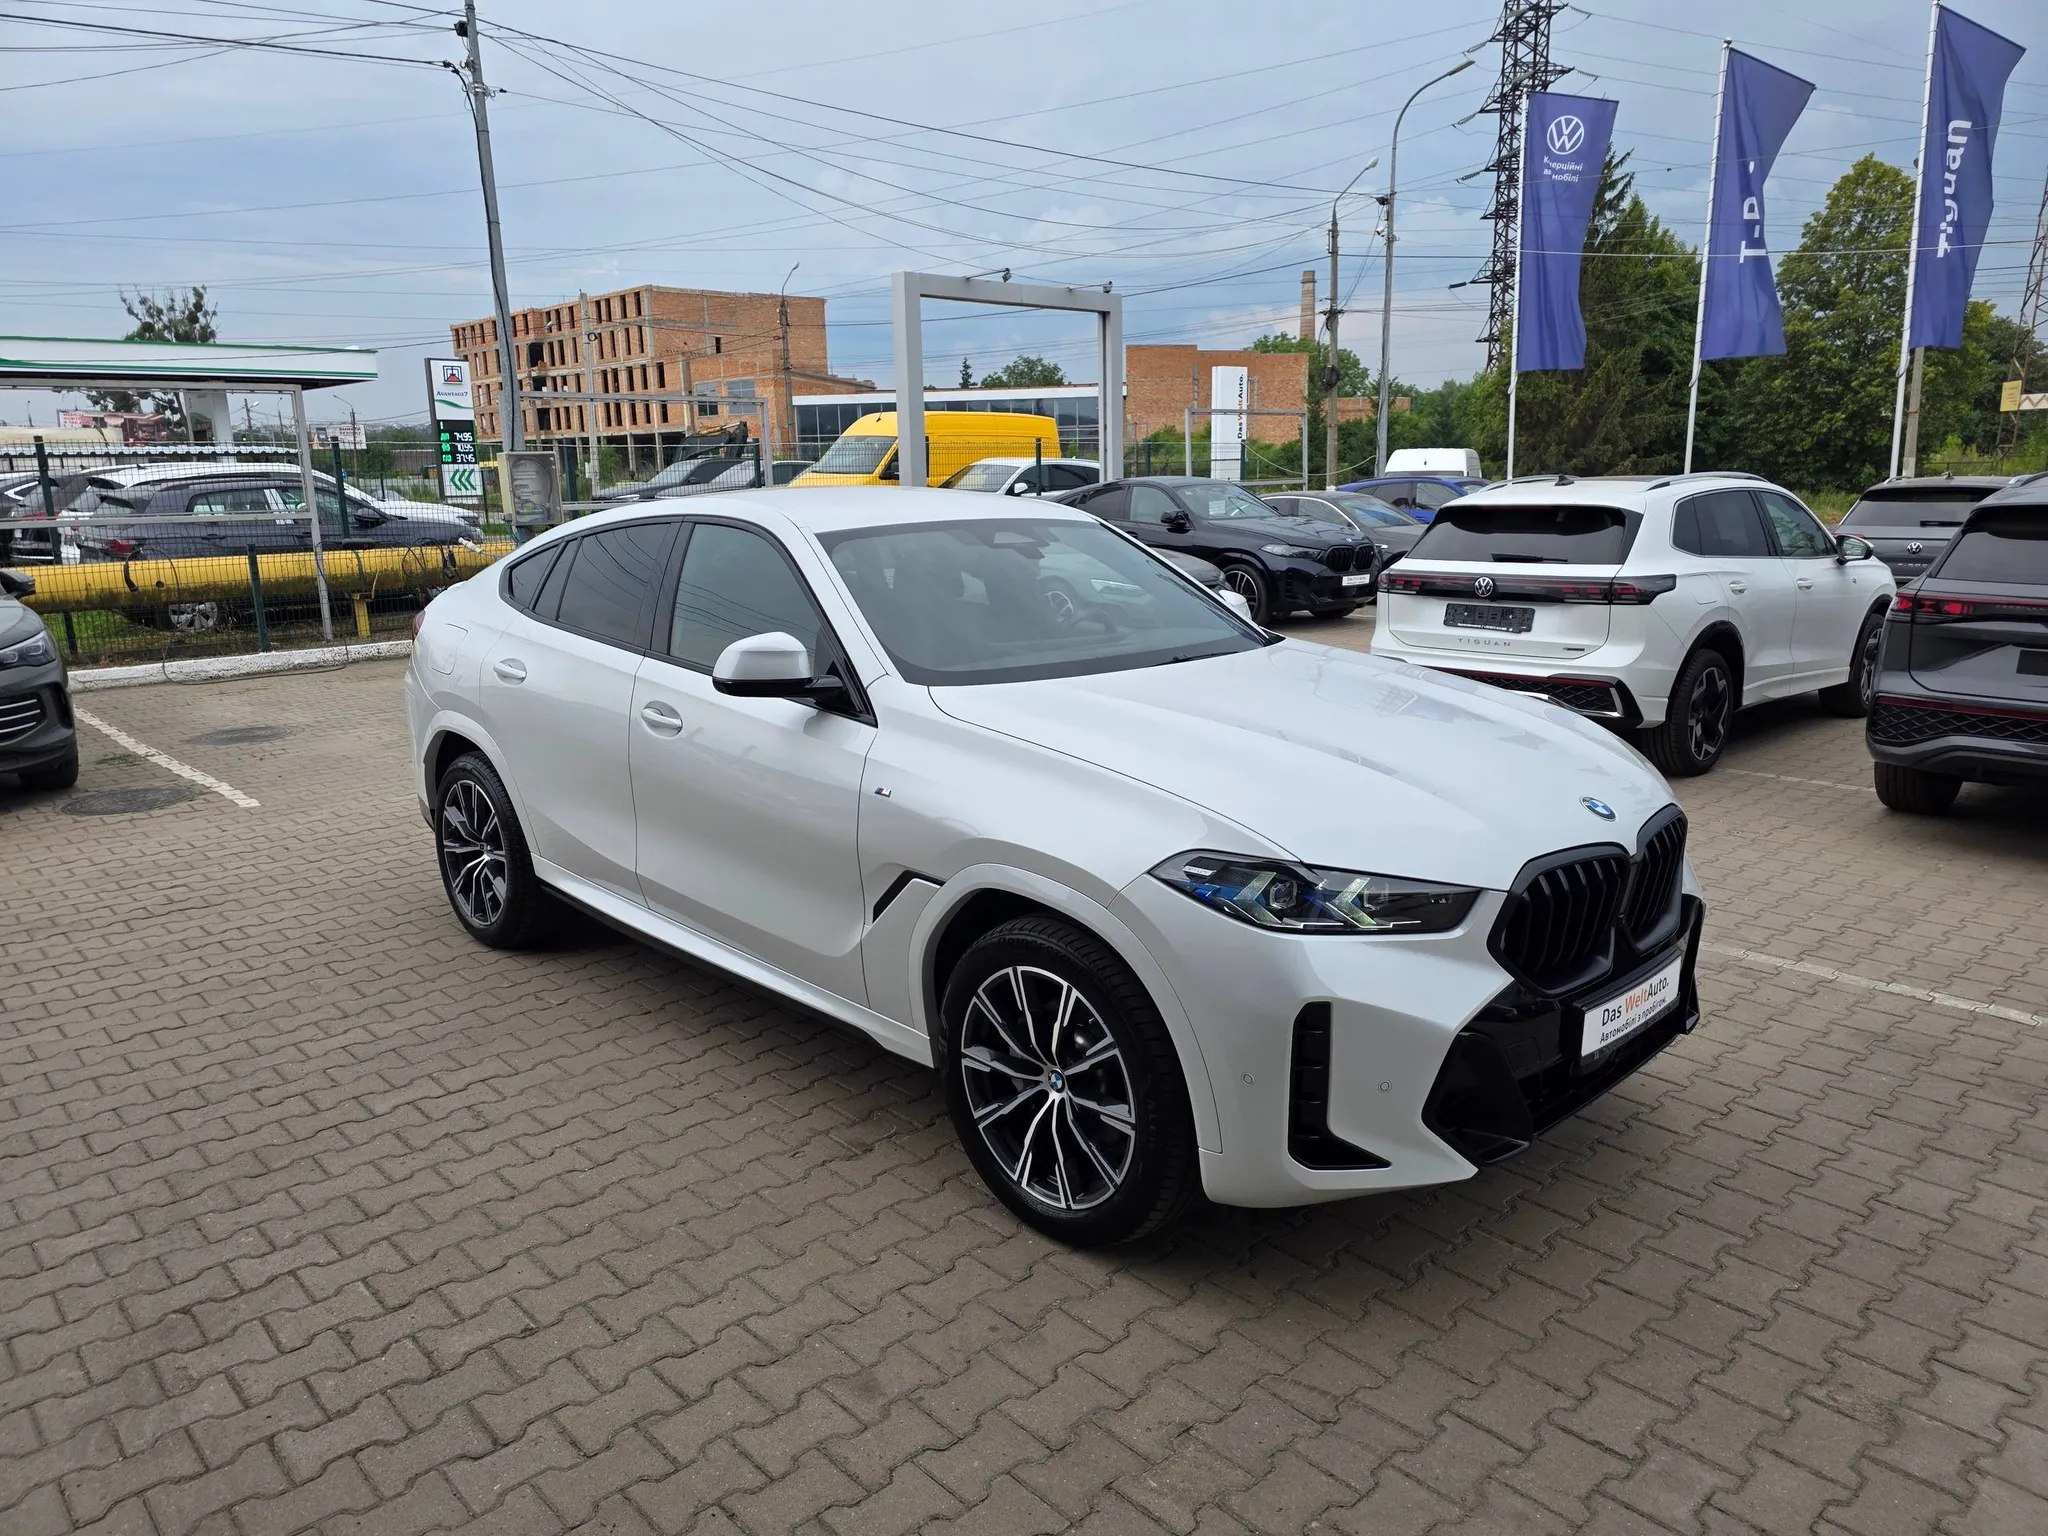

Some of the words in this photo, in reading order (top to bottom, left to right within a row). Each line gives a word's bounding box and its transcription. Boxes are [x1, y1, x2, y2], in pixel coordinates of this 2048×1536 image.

[1457, 637, 1511, 647] TIGUAN
[1602, 1005, 1622, 1027] Das
[1625, 976, 1669, 1013] WeltAuto.
